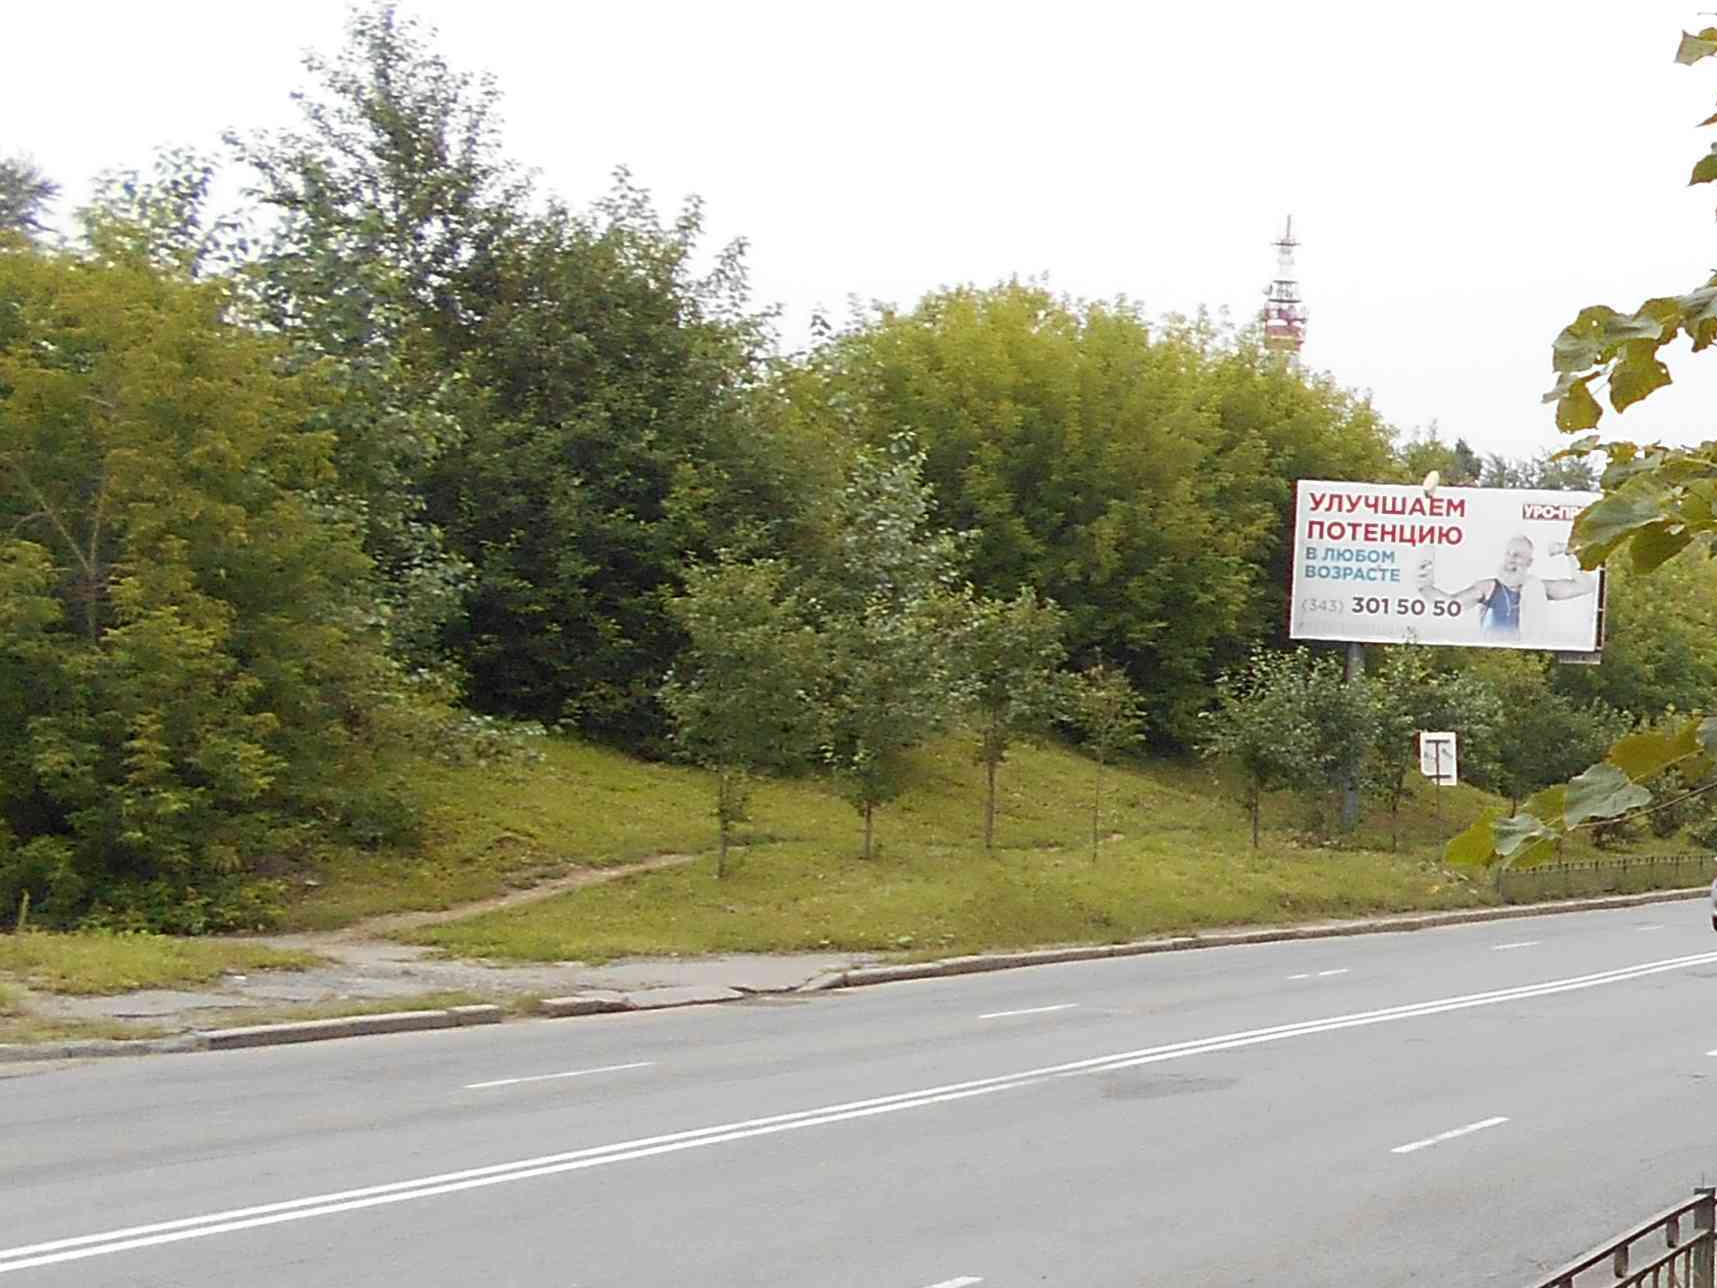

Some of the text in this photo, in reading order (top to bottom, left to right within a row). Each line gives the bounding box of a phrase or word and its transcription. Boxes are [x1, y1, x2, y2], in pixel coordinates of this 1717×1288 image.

[1309, 493, 1466, 518] УЛУЧШАЕМ
[1307, 521, 1464, 547] ПОТЕНЦИЮ
[1306, 547, 1396, 564] В ЛЮБОМ
[1305, 566, 1400, 582] ВОЗРАСТЕ
[1352, 597, 1389, 614] 301
[1396, 599, 1425, 615] 50
[1433, 600, 1462, 617] 50
